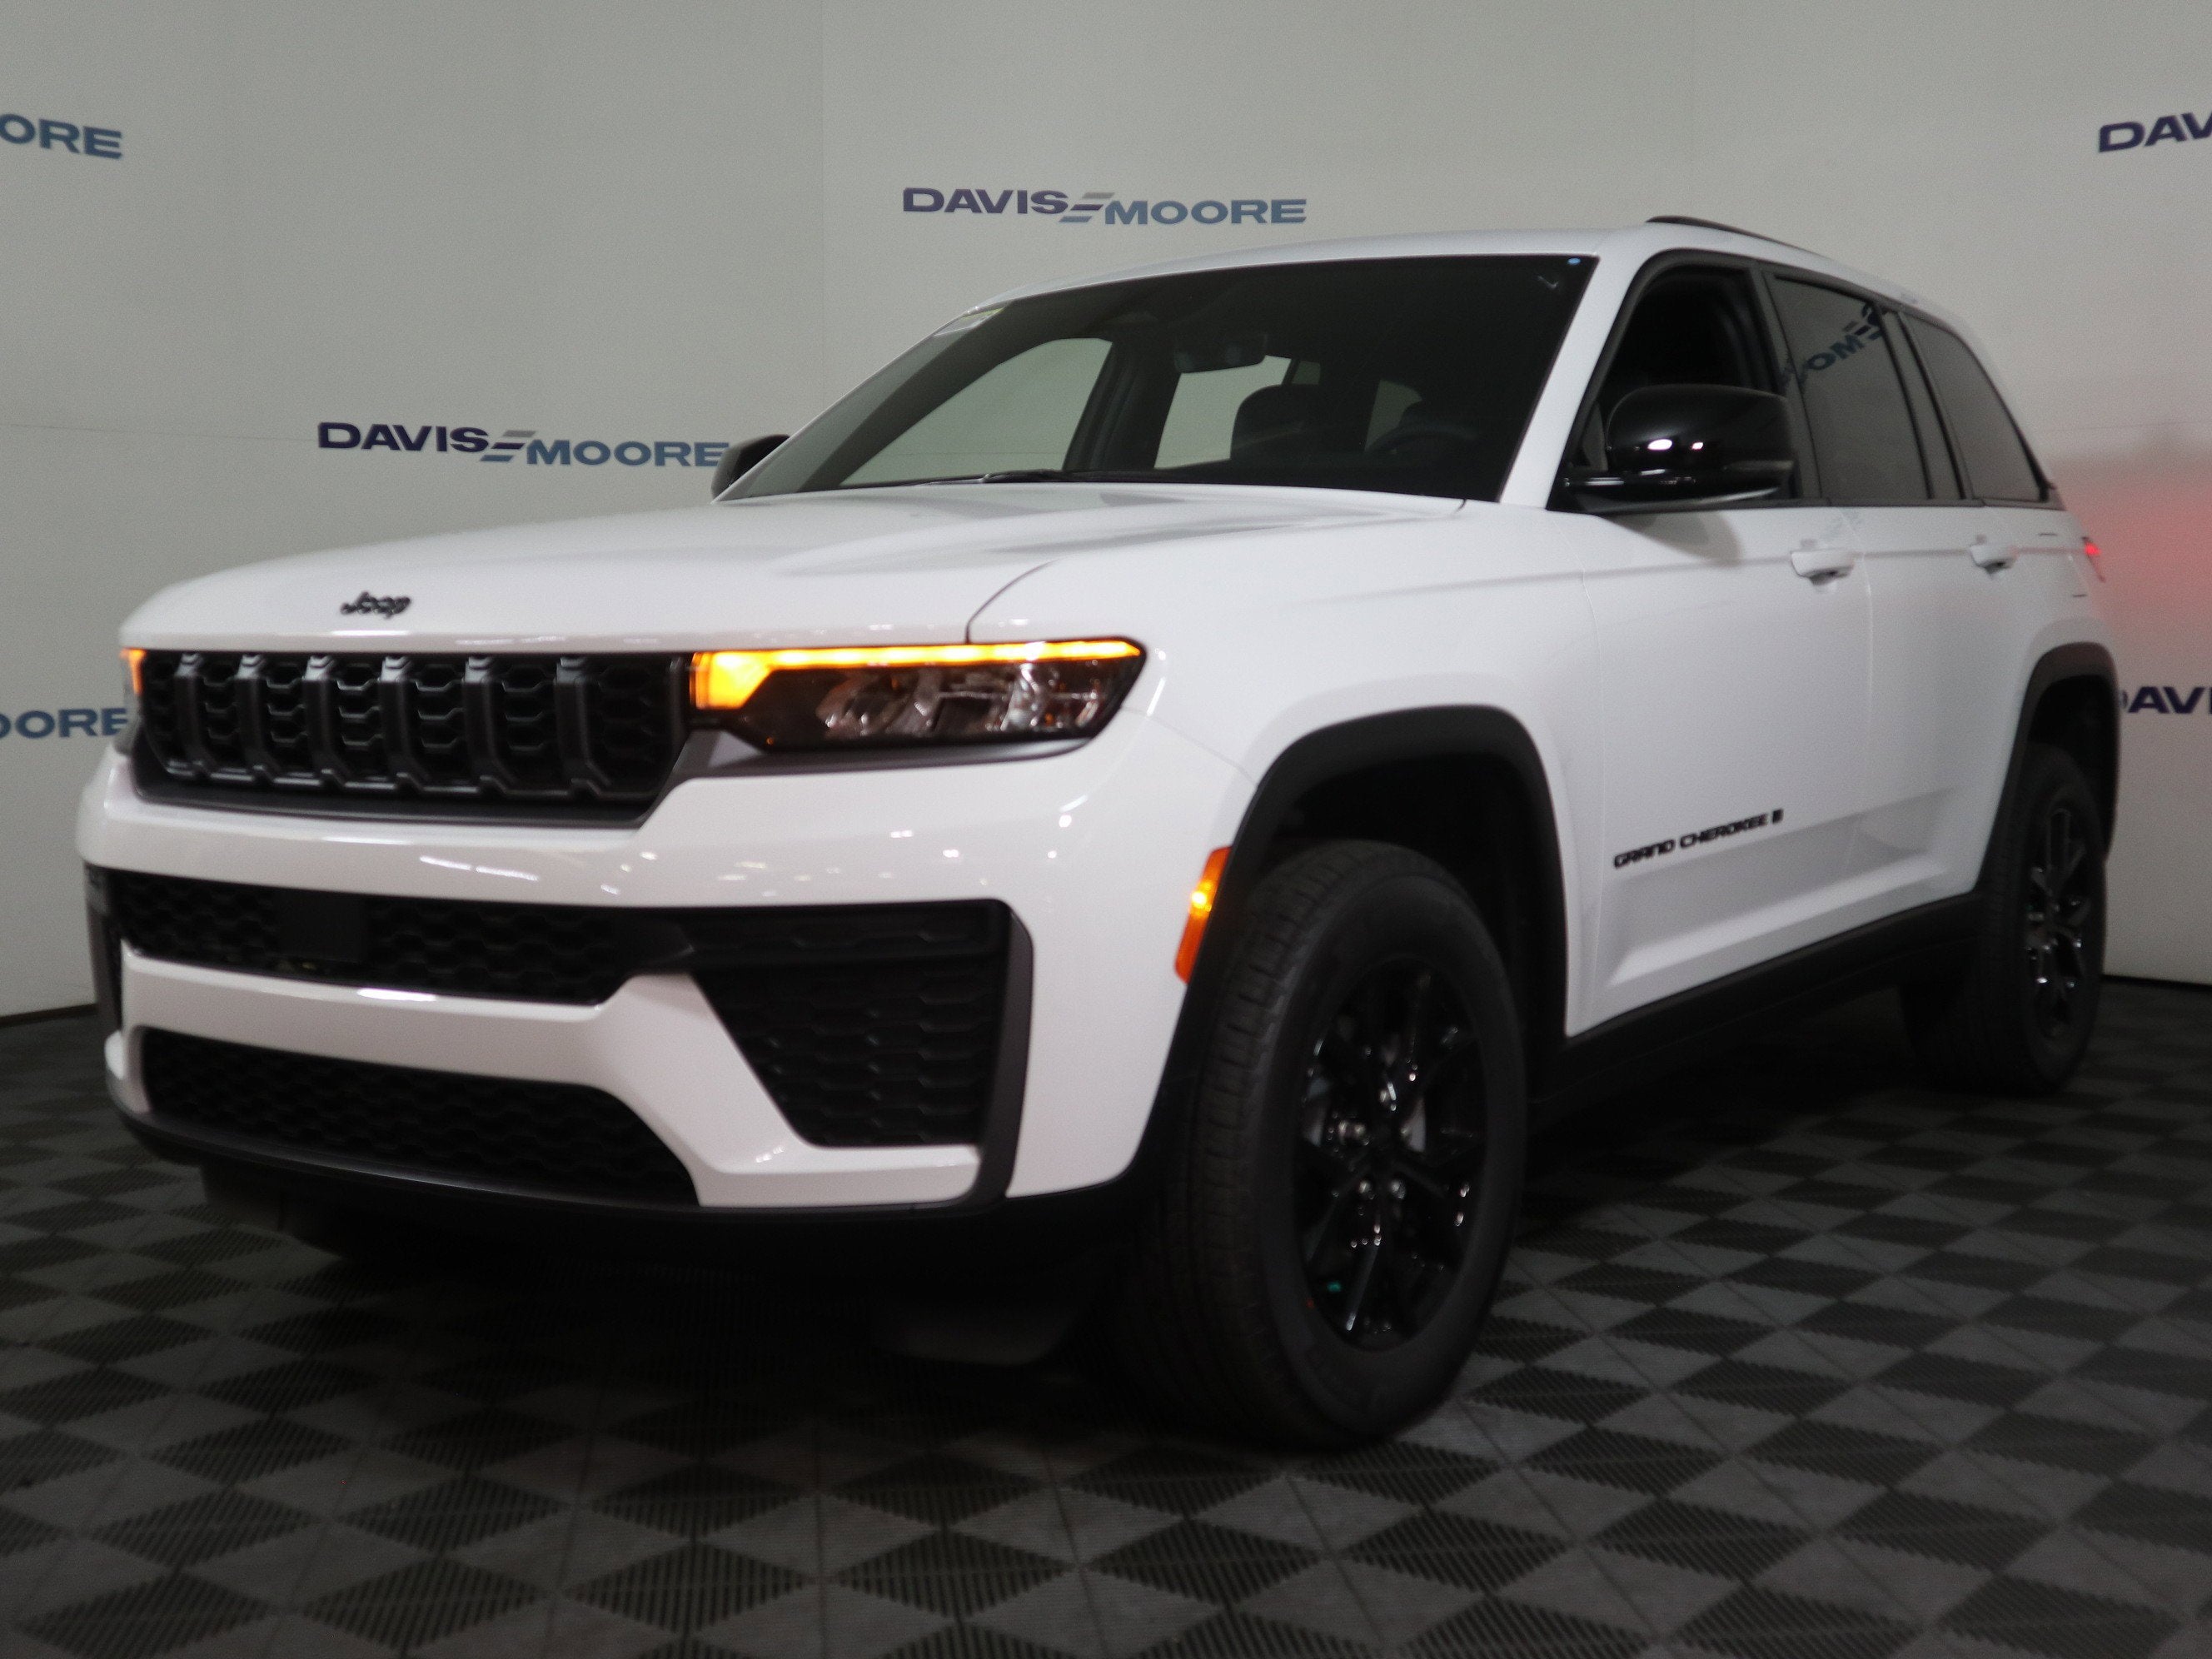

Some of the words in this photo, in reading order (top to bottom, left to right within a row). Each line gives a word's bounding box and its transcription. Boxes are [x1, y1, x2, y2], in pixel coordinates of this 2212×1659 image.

[902, 187, 1069, 215] DAVIS
[1104, 198, 1307, 226] MOORE
[317, 421, 490, 452] DAVIS
[526, 438, 730, 467] MOORE
[340, 590, 411, 619] Jeep
[0, 707, 128, 740] ORE
[1613, 839, 1676, 869] GRAND
[1679, 813, 1768, 849] CHEROKEE
